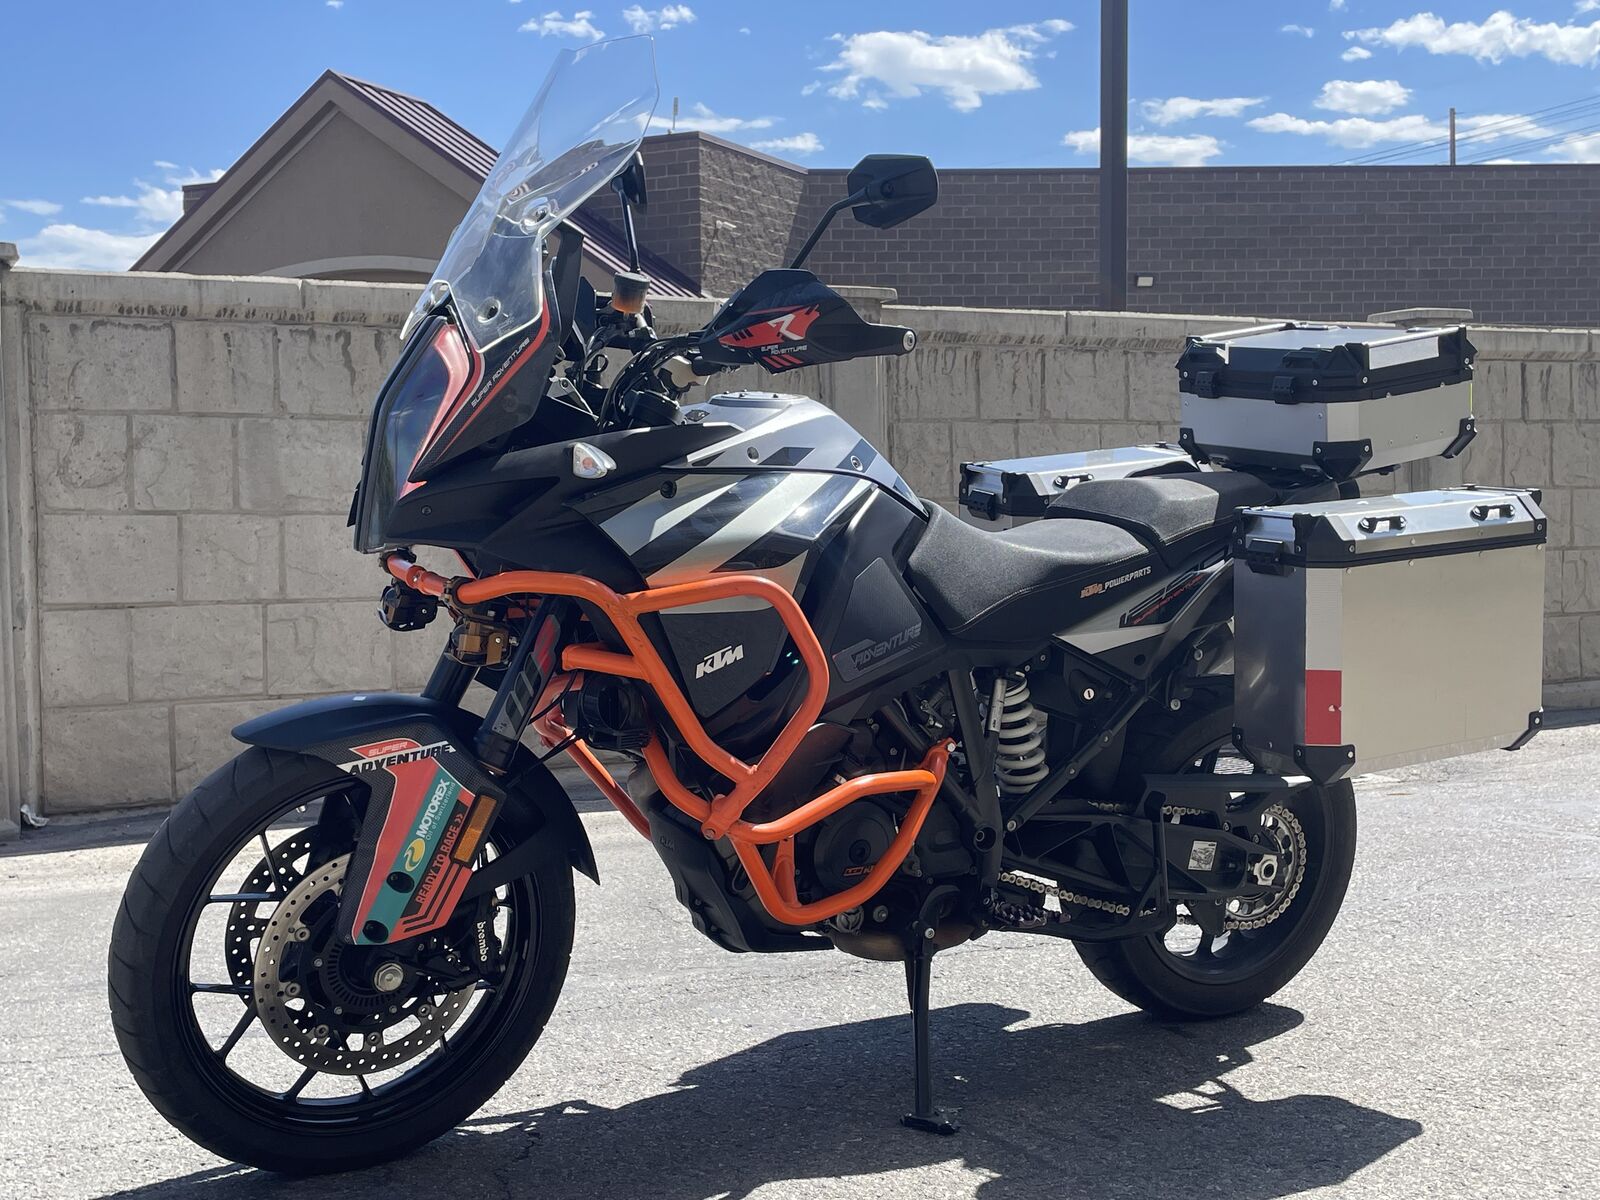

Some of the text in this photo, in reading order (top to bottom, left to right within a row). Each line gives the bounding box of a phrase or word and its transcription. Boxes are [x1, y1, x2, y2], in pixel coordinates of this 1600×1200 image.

[470, 380, 492, 408] SUPER
[492, 337, 530, 381] ADVENTURE
[695, 644, 744, 679] KTM
[854, 622, 922, 668] ADVENTURE
[349, 745, 451, 775] ADVENTURE
[367, 741, 408, 757] SUPER
[416, 779, 450, 838] MOTOREX
[426, 830, 434, 840] Oil
[435, 782, 456, 820] Switzerland
[415, 825, 460, 904] READY TO RACE
[476, 921, 488, 962] brembo
